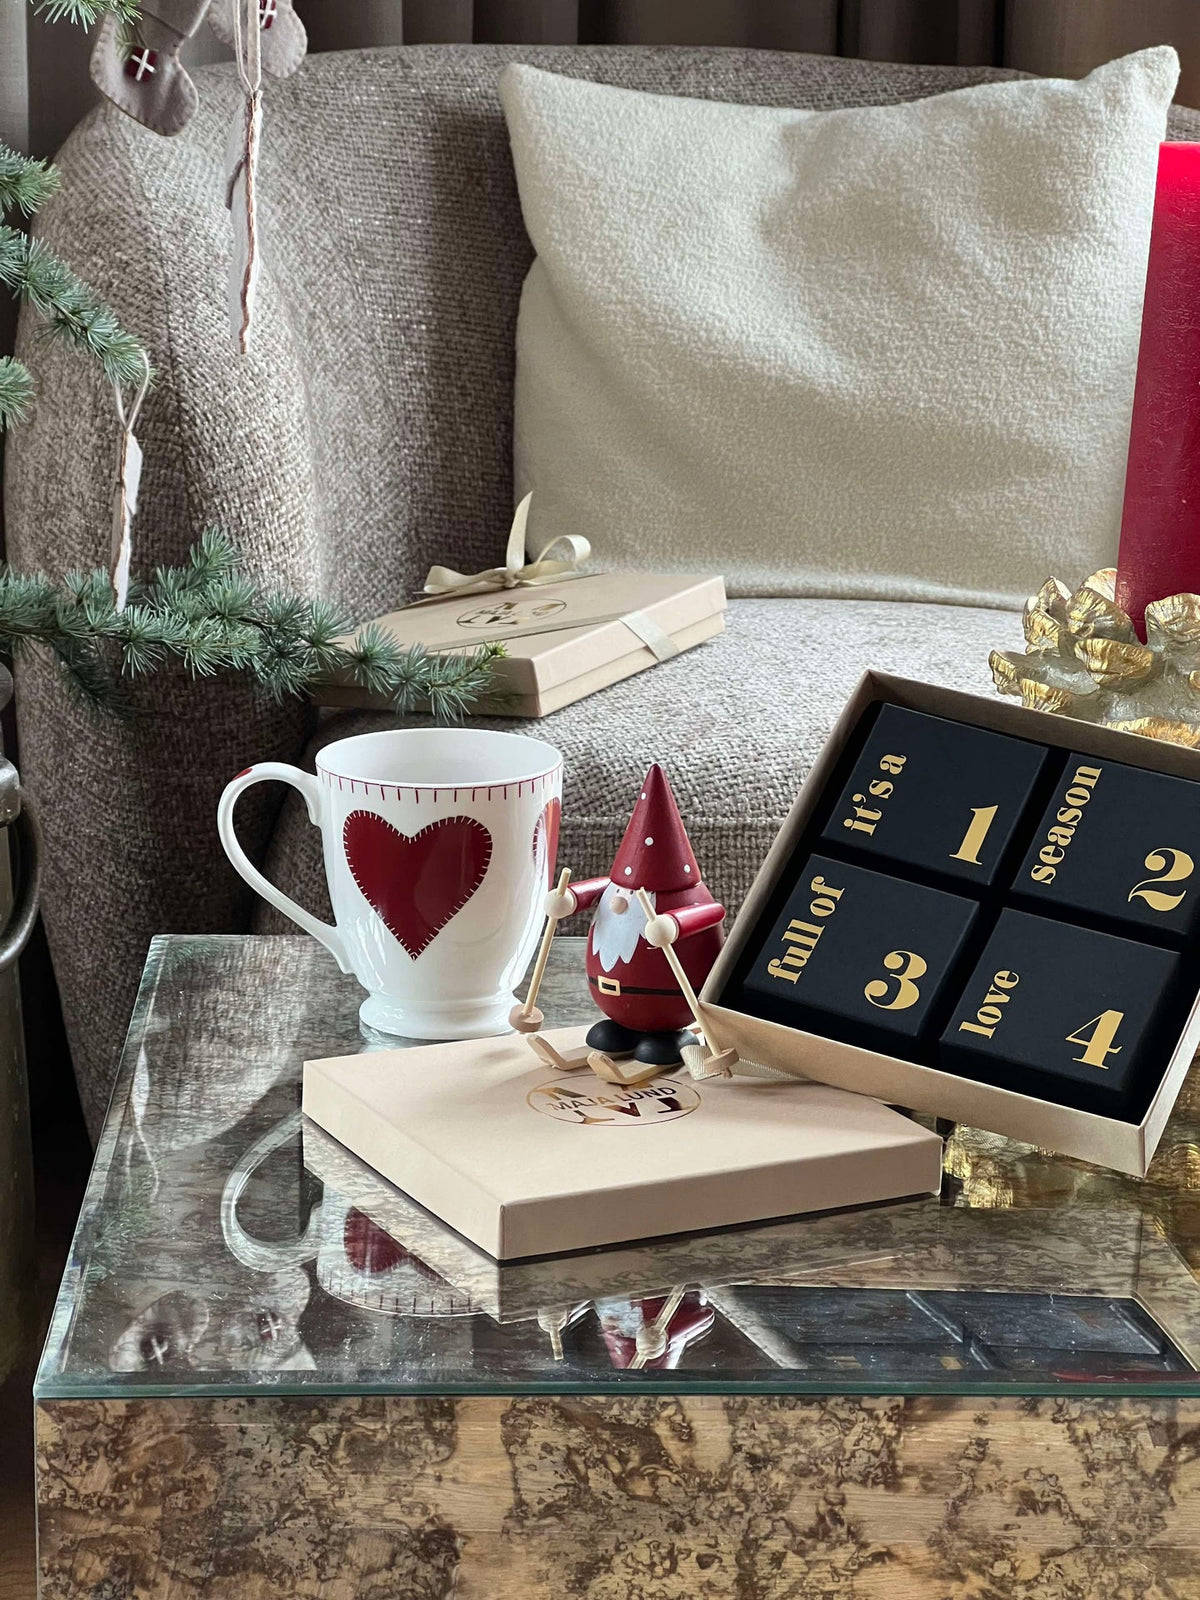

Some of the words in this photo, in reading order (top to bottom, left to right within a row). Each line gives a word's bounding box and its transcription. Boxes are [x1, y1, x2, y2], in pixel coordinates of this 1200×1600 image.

[843, 779, 894, 836] it's
[879, 754, 907, 775] a
[1031, 764, 1103, 885] season
[949, 805, 999, 865] 1
[1127, 847, 1195, 912] 2
[767, 918, 826, 985] full
[810, 875, 846, 917] of
[864, 950, 928, 1010] 3
[958, 969, 1020, 1039] love
[1065, 1009, 1124, 1069] 4
[546, 1097, 615, 1111] MAJA
[614, 1086, 677, 1102] LUND
